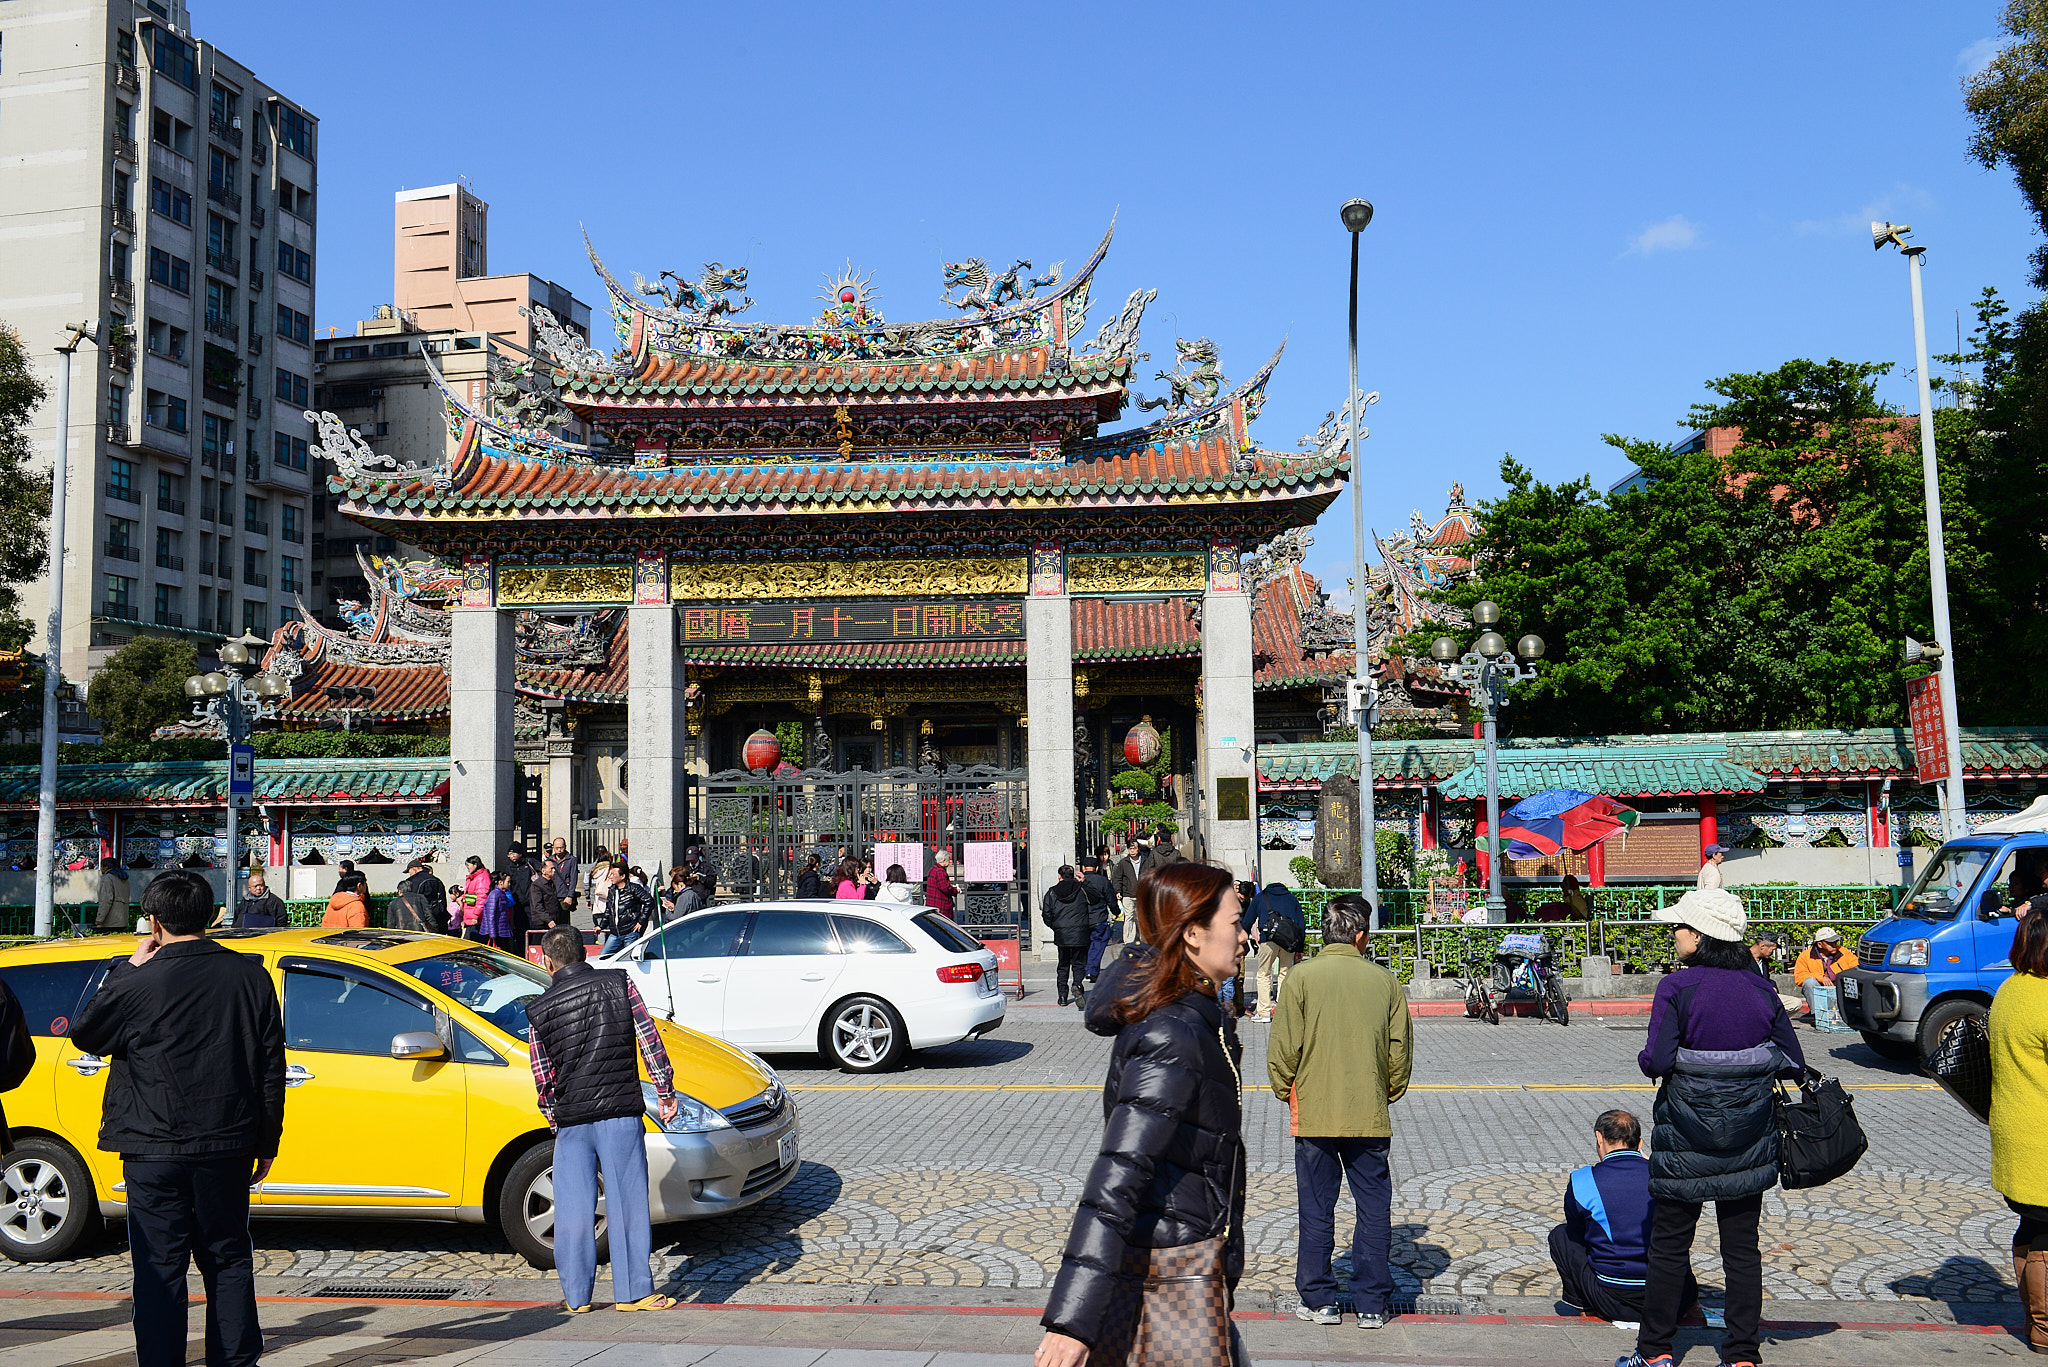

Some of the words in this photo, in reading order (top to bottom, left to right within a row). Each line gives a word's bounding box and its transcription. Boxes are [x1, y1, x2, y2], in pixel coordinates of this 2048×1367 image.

[685, 603, 1022, 640] 國曆一月十一日開使受
[1928, 677, 1948, 774] 觀光地區禁止設
[1329, 801, 1344, 865] 龍山寺
[440, 968, 463, 986] 空車
